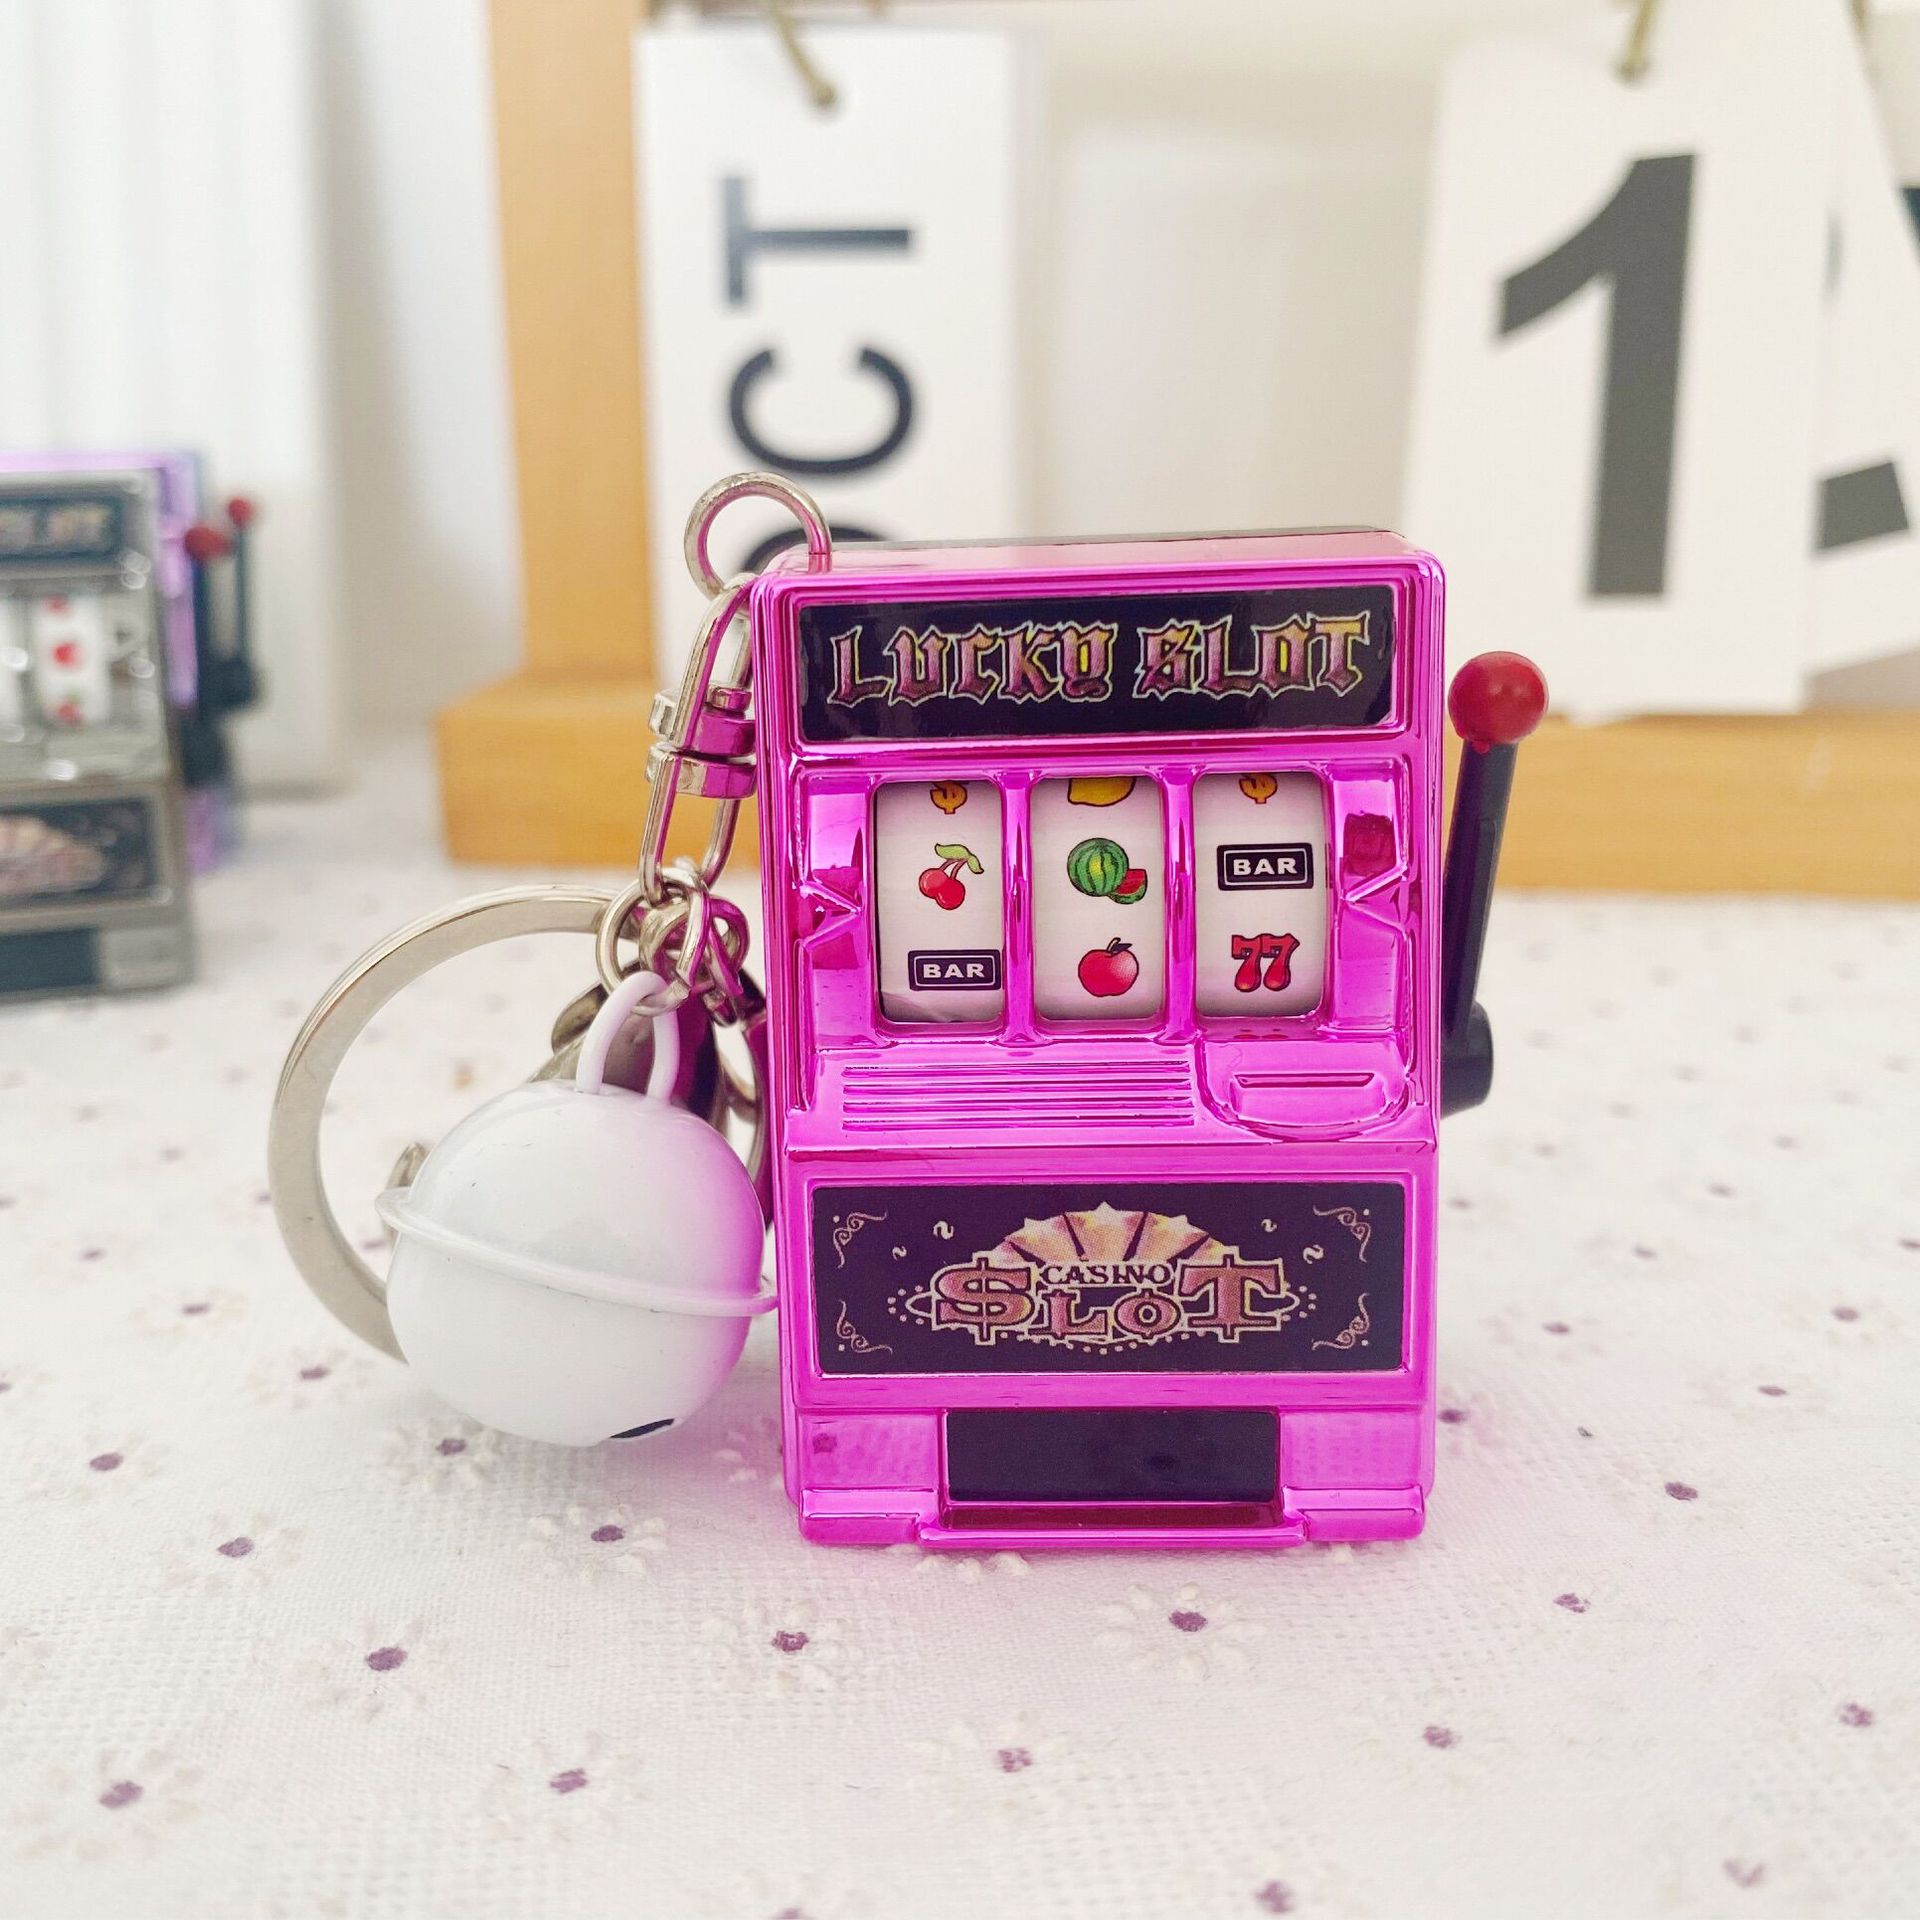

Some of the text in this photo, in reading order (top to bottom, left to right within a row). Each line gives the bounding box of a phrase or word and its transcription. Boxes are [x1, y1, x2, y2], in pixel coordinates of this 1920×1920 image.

[719, 174, 914, 573] CT
[1496, 151, 1698, 597] 1
[827, 611, 1371, 707] LUCKY SLOT
[1232, 856, 1298, 876] BAR
[922, 962, 985, 979] BAR
[1231, 933, 1300, 992] 77
[1041, 1263, 1175, 1286] CASINO
